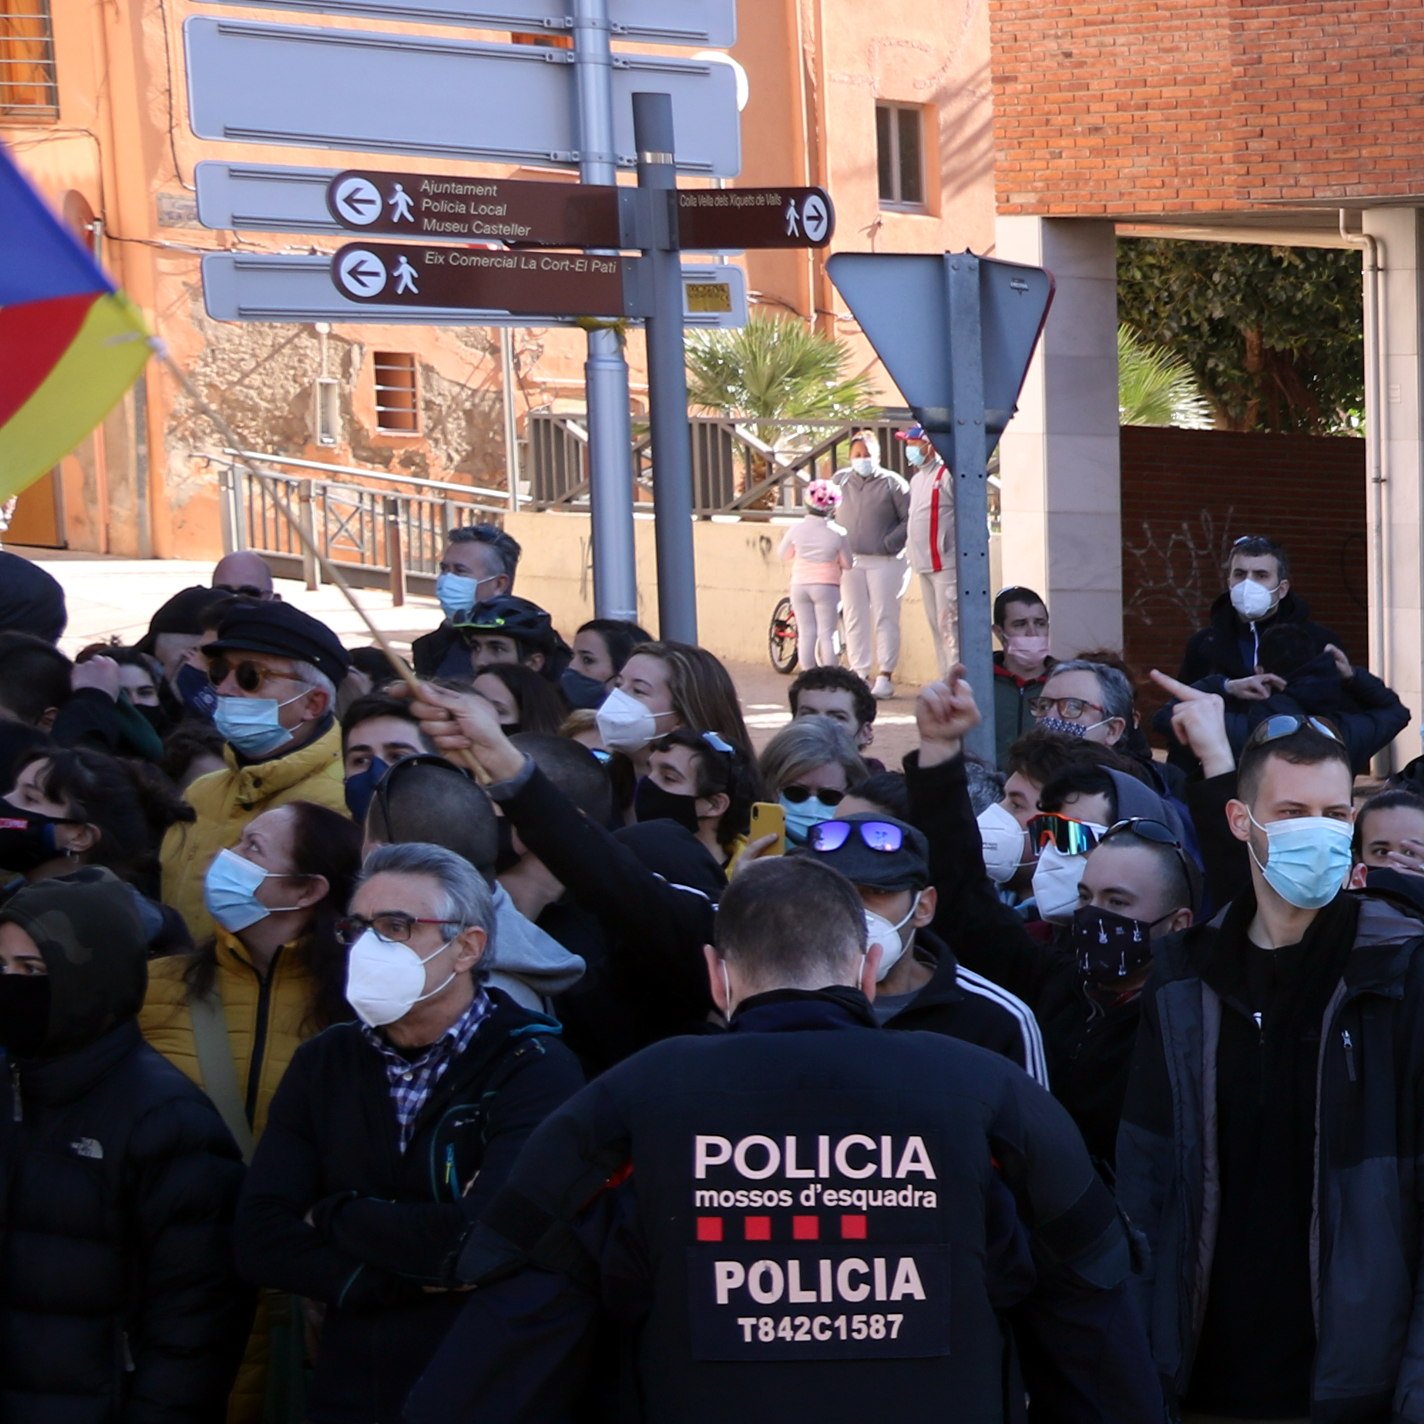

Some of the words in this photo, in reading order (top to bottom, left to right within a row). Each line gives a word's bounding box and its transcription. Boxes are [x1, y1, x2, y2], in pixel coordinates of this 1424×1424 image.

[420, 179, 498, 197] Ajuntament
[421, 199, 467, 214] Policia
[470, 202, 507, 217] Local
[679, 194, 699, 208] Colla
[699, 194, 715, 208] Vella
[715, 194, 729, 207] dels
[729, 193, 755, 209] Xiquets
[755, 194, 765, 206] de
[766, 193, 782, 206] Valls
[422, 219, 469, 234] Museu
[472, 220, 532, 237] Casteller
[424, 251, 445, 265] Eix
[449, 252, 518, 269] Comercial
[521, 256, 537, 270] La
[540, 257, 588, 272] Cort-El
[591, 259, 618, 275] Pati
[694, 1134, 937, 1180] POLICIA
[694, 1188, 793, 1208] mossos
[799, 1184, 938, 1211] d'esquadra
[714, 1257, 927, 1305] POLICIA
[737, 1313, 904, 1343] T842C1587
